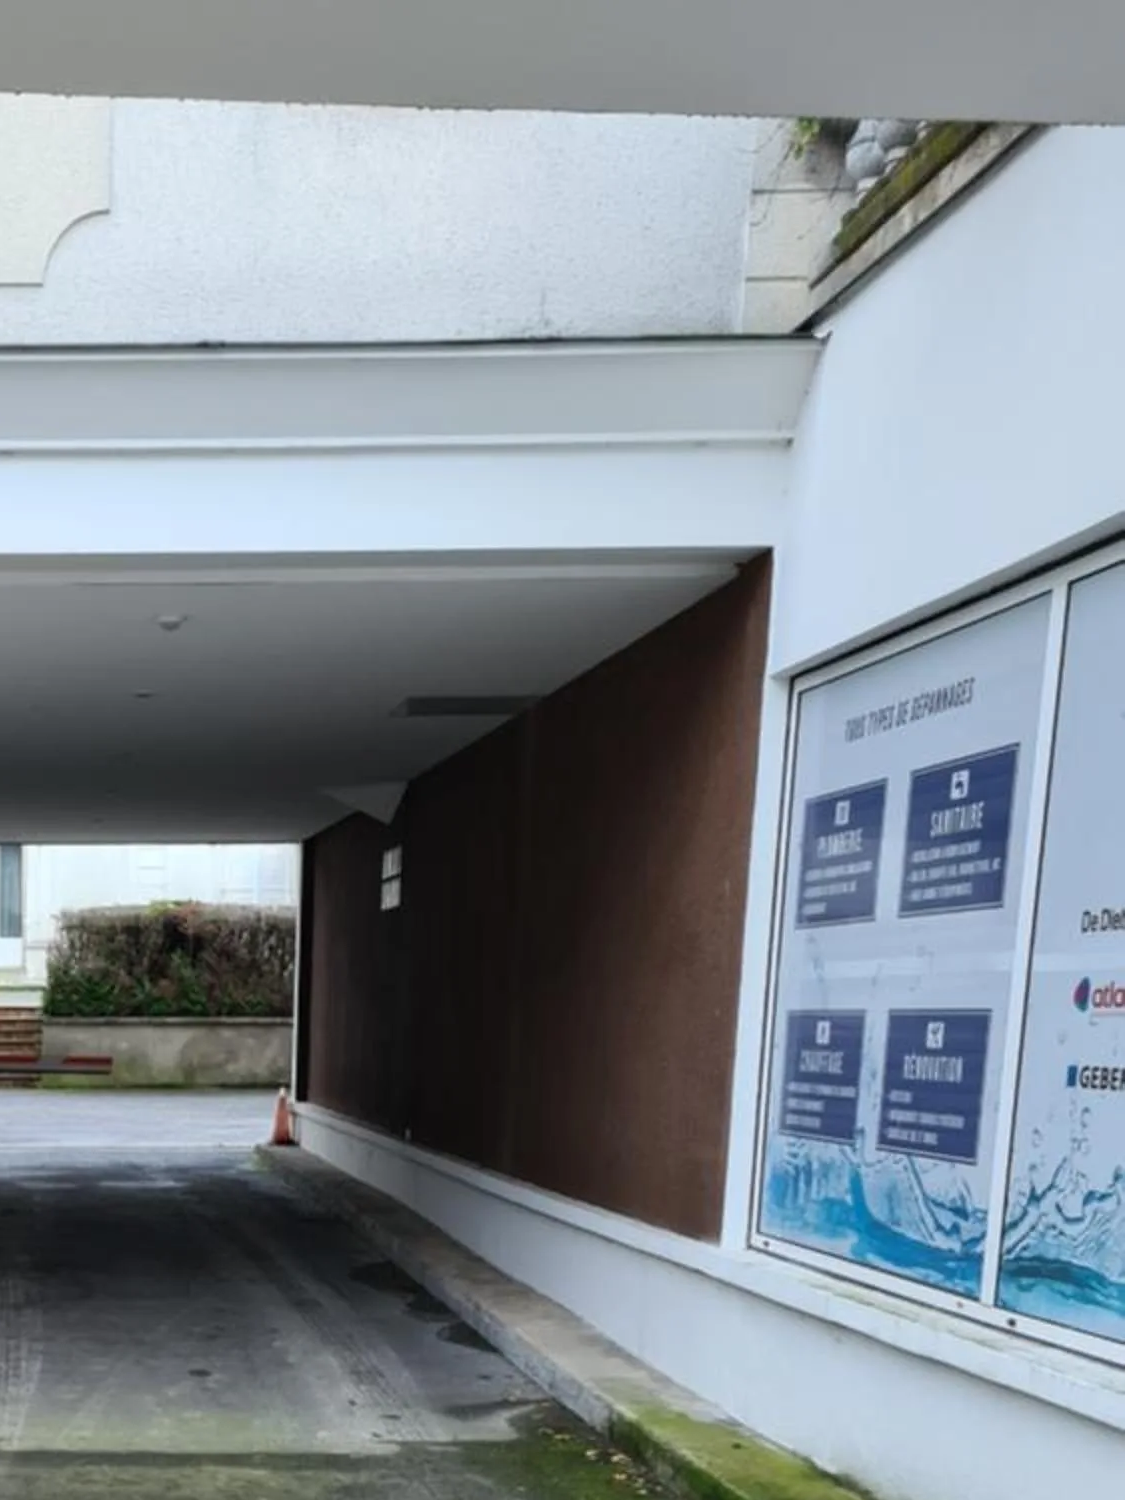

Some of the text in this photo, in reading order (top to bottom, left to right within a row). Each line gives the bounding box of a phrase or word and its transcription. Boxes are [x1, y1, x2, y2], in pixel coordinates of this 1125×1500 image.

[867, 705, 895, 736] TYPES
[895, 699, 910, 728] DE
[930, 801, 985, 838] SANITAIRE
[1081, 910, 1099, 934] De
[903, 1050, 964, 1083] RÉNOVATION
